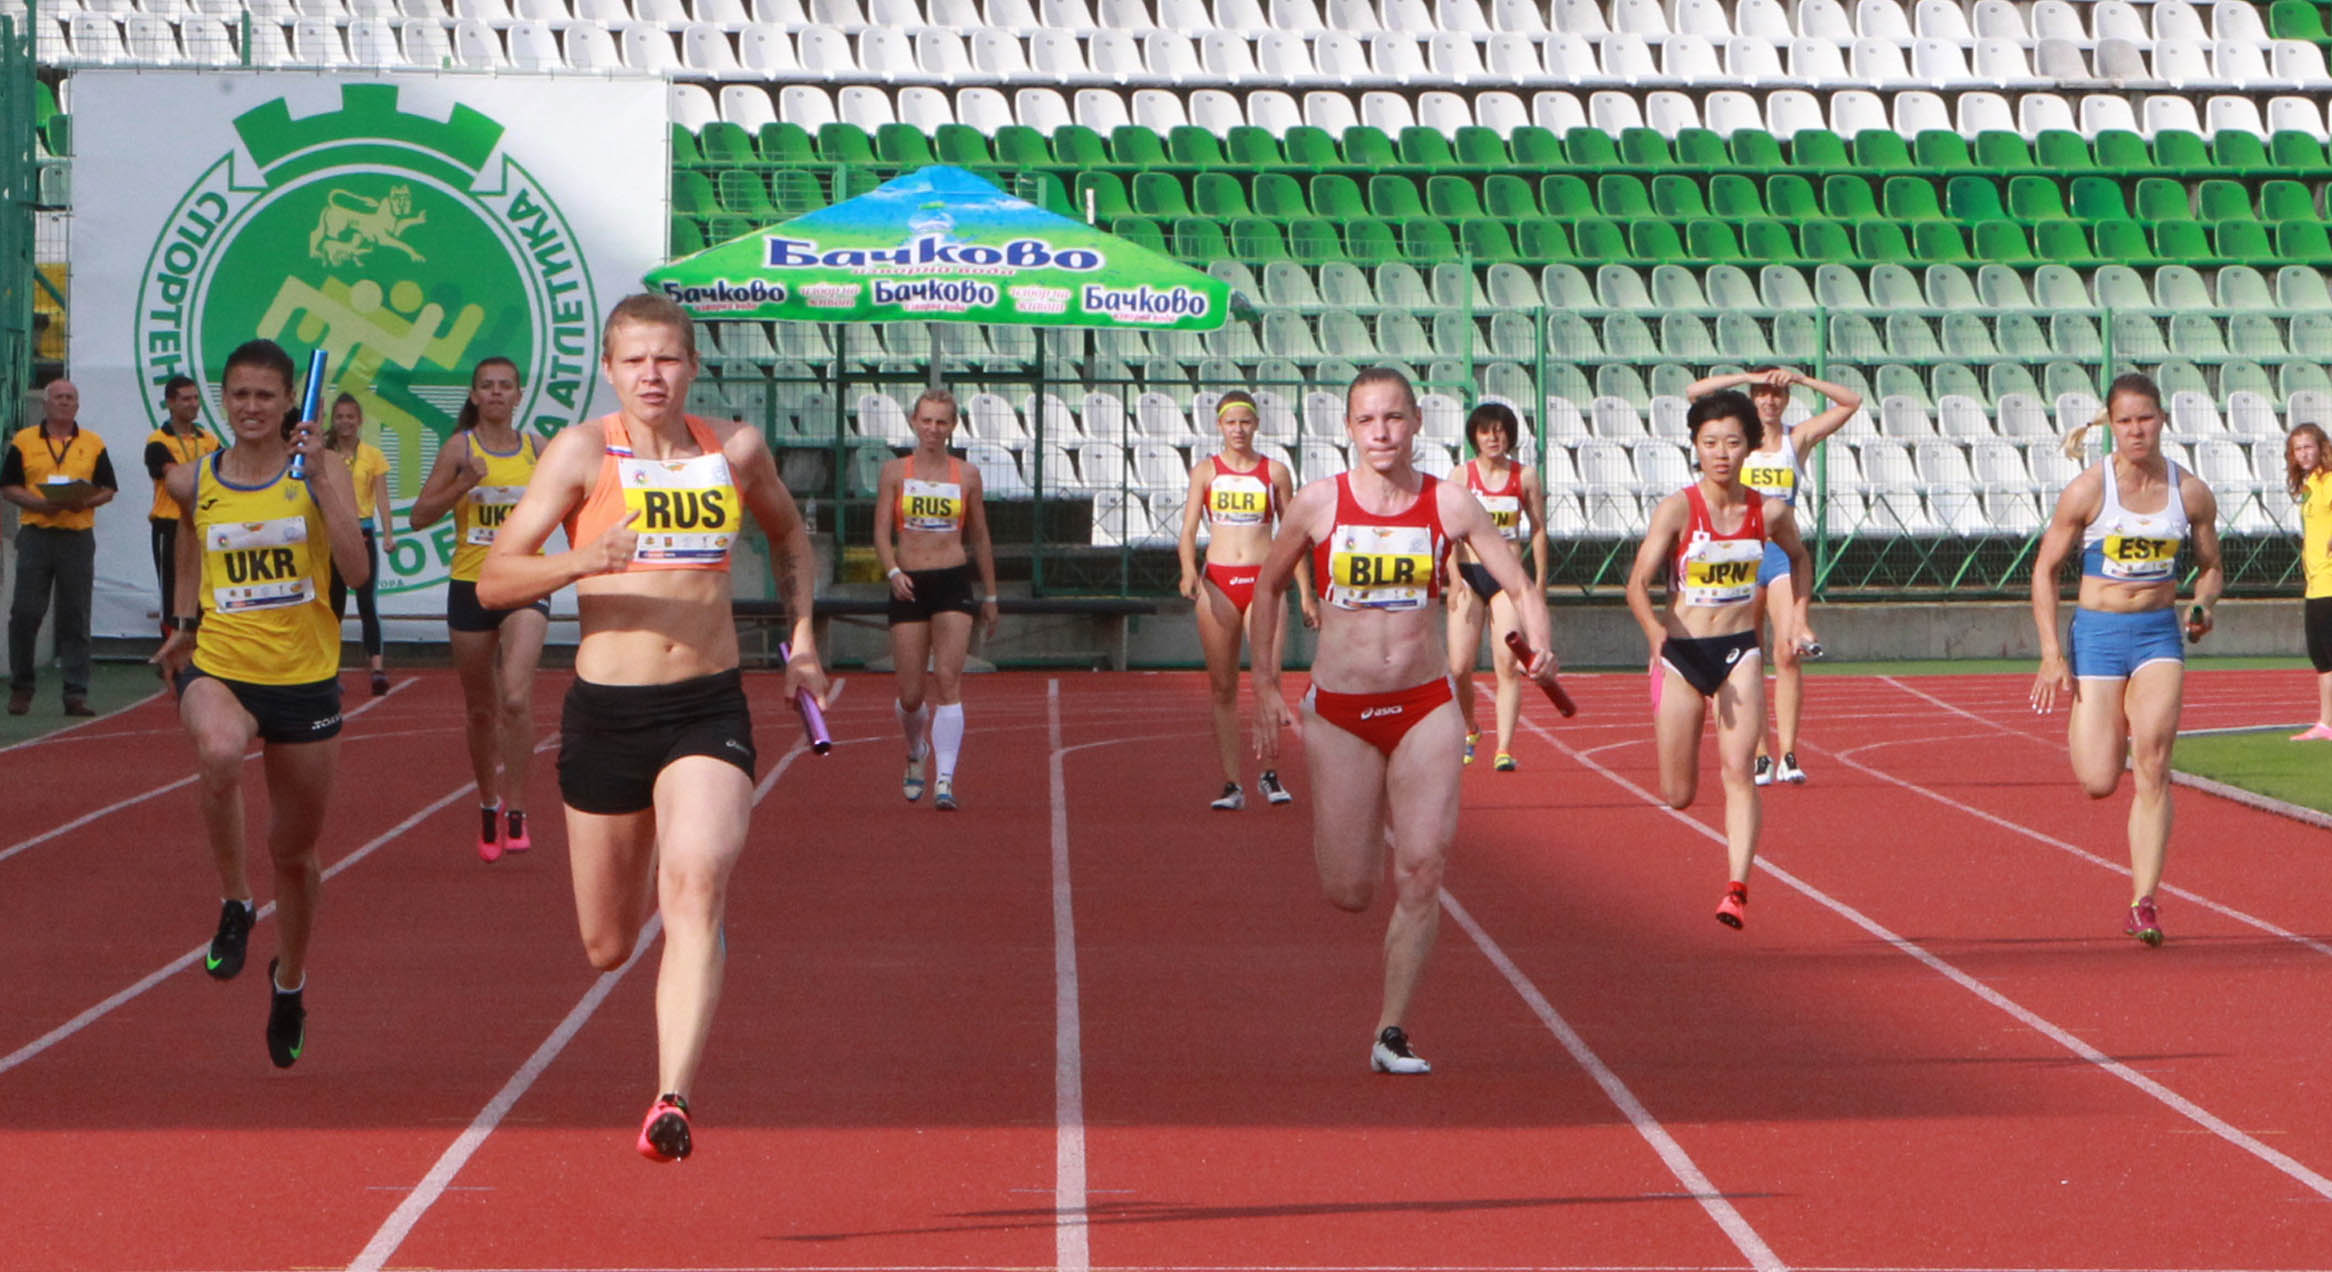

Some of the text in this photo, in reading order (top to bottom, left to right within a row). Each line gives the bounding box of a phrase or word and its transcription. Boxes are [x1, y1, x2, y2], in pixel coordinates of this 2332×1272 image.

[770, 237, 1099, 269] Бачково
[149, 191, 229, 386] СПОРТЕН
[507, 188, 585, 410] АТЛЕТИКА
[663, 280, 785, 303] Бачково
[875, 279, 995, 304] Бачково
[1085, 286, 1206, 315] Бачково
[1751, 467, 1785, 485] EST
[644, 489, 726, 529] RUS
[911, 496, 952, 517] RUS
[1217, 491, 1256, 511] BLR
[480, 504, 517, 526] UK
[2119, 536, 2167, 560] EST
[224, 548, 298, 584] UKR
[1350, 556, 1415, 586] BLR
[1700, 562, 1749, 585] JPN
